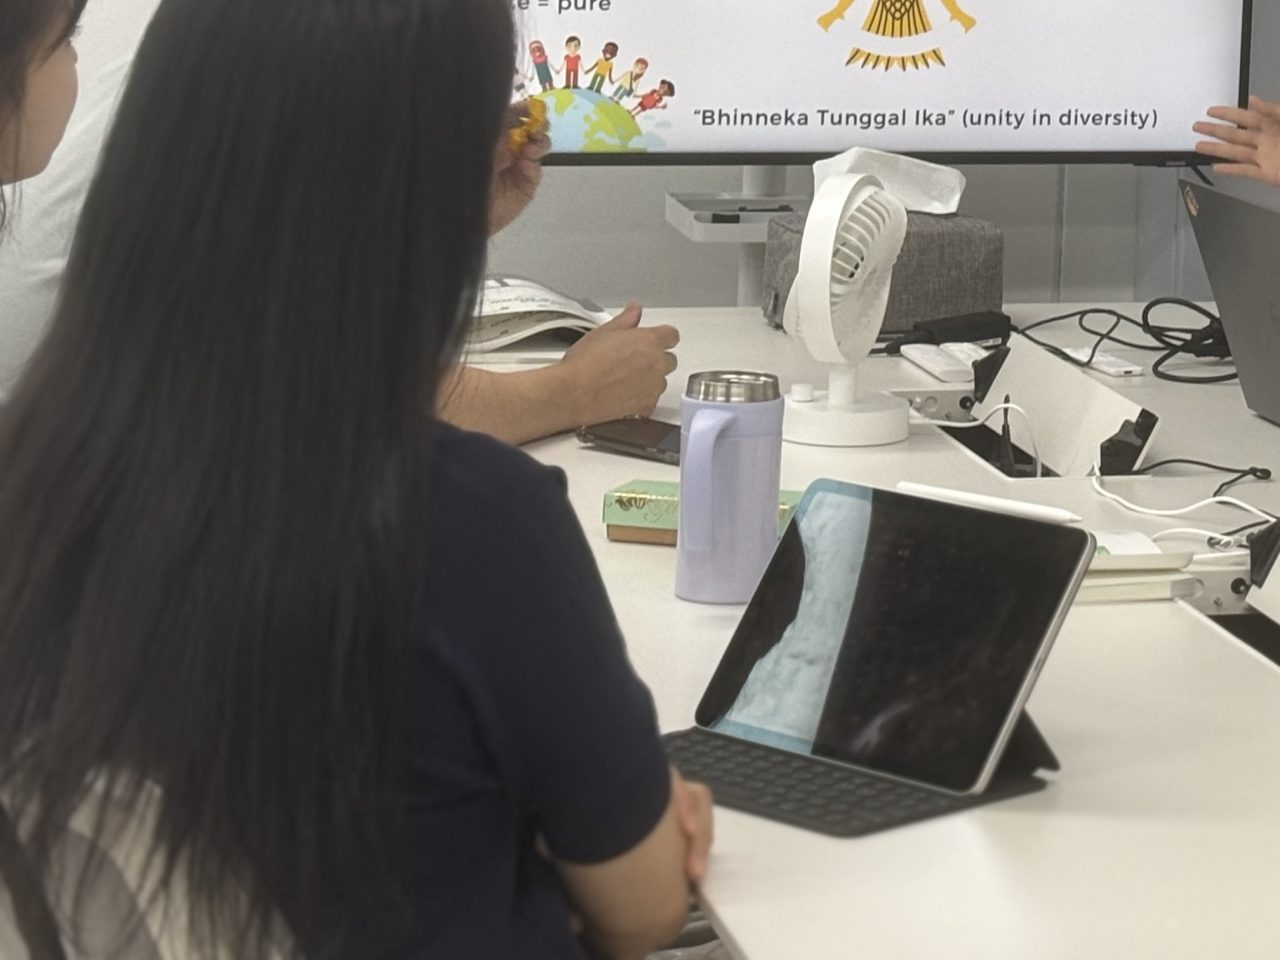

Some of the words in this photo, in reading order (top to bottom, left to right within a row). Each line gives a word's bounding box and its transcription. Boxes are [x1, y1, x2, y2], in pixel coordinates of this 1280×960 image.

[817, 109, 906, 130] Tunggal
[963, 109, 1025, 130] (unity
[1033, 109, 1051, 126] in
[1059, 109, 1157, 130] diversity)
